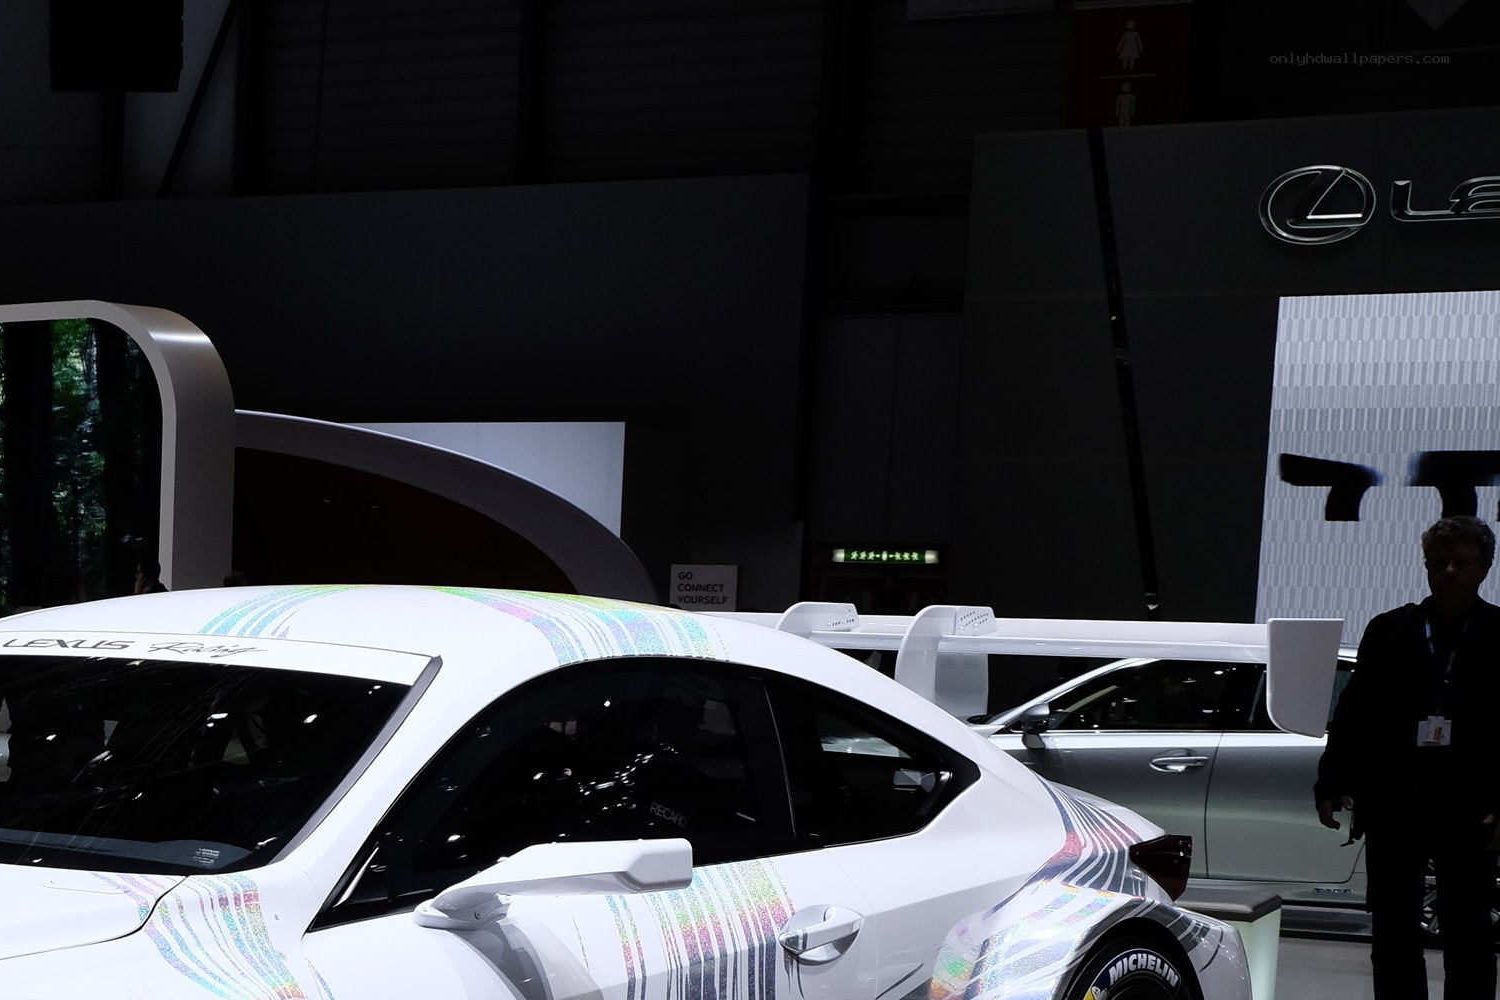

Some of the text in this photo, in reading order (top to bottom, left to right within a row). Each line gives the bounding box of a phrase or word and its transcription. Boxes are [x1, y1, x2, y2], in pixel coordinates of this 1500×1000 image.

[677, 571, 694, 581] GO
[677, 583, 725, 593] CONNECT
[677, 595, 729, 605] YOURSELF
[1, 638, 136, 651] LEXUS
[1108, 953, 1179, 988] MICHELIN
